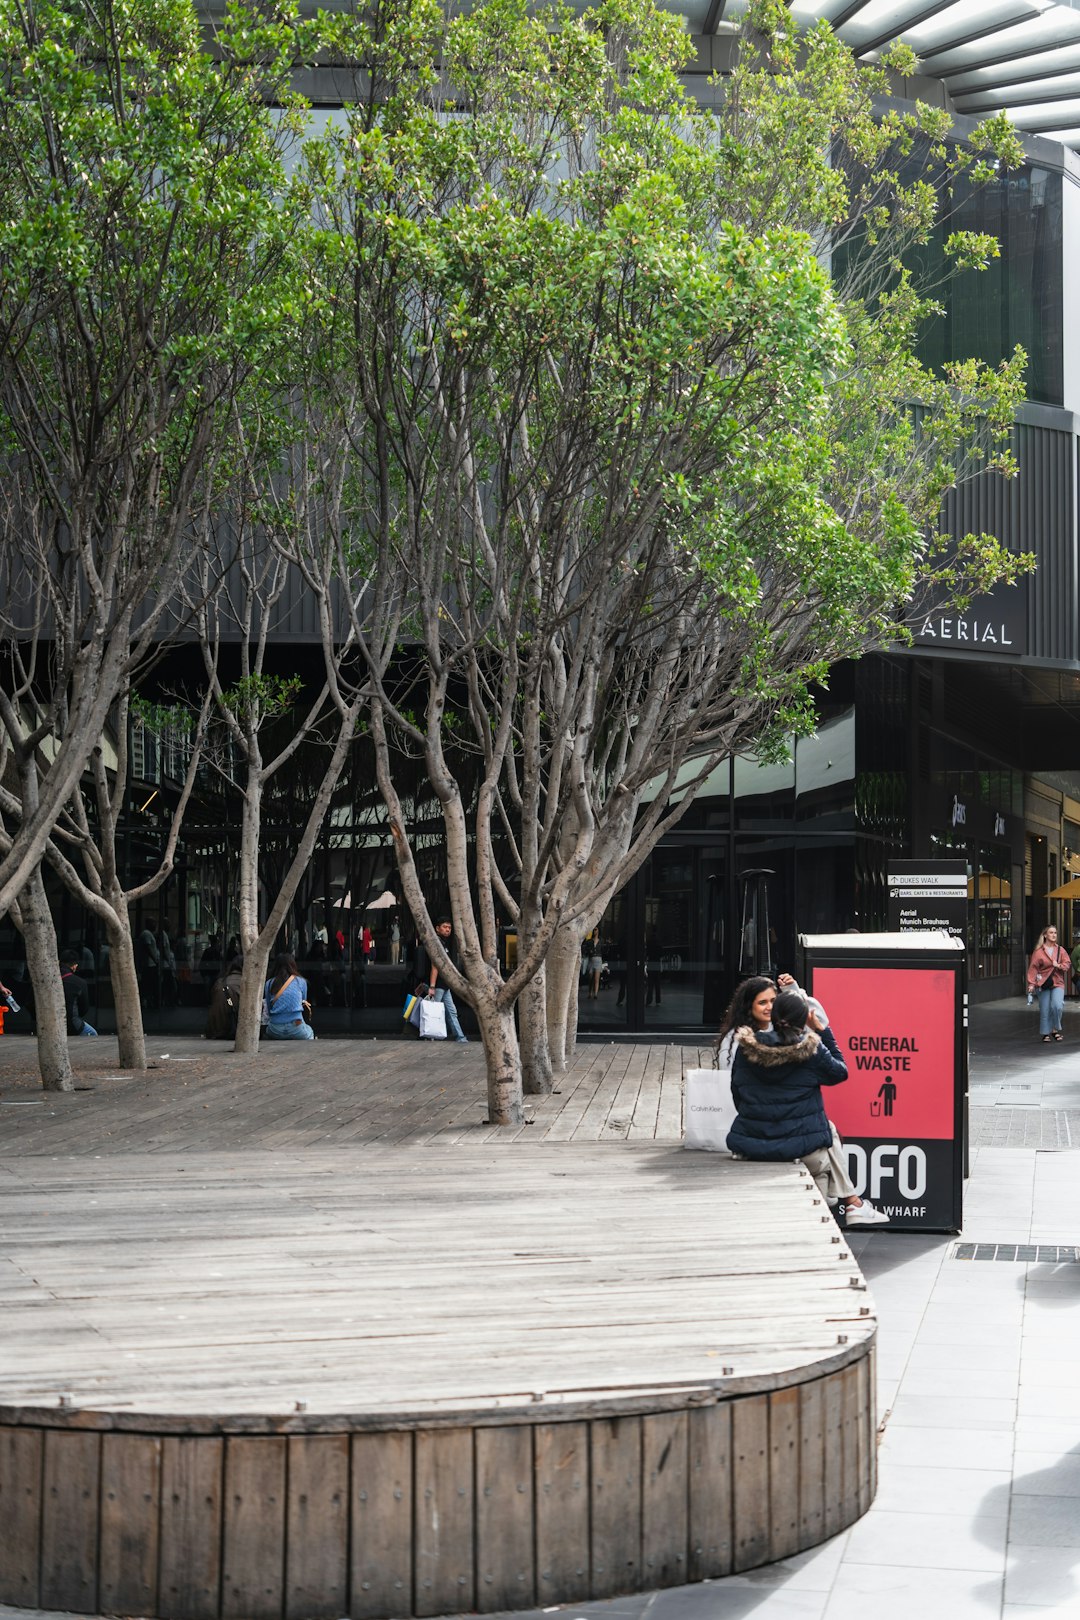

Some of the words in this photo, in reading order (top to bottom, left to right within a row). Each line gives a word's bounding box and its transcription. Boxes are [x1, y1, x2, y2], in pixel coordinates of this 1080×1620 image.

[921, 616, 1012, 645] AERIAL
[849, 1036, 919, 1052] GENERAL
[856, 1056, 911, 1071] WASTE
[842, 1144, 926, 1200] DFO
[883, 1206, 927, 1217] WHARF
